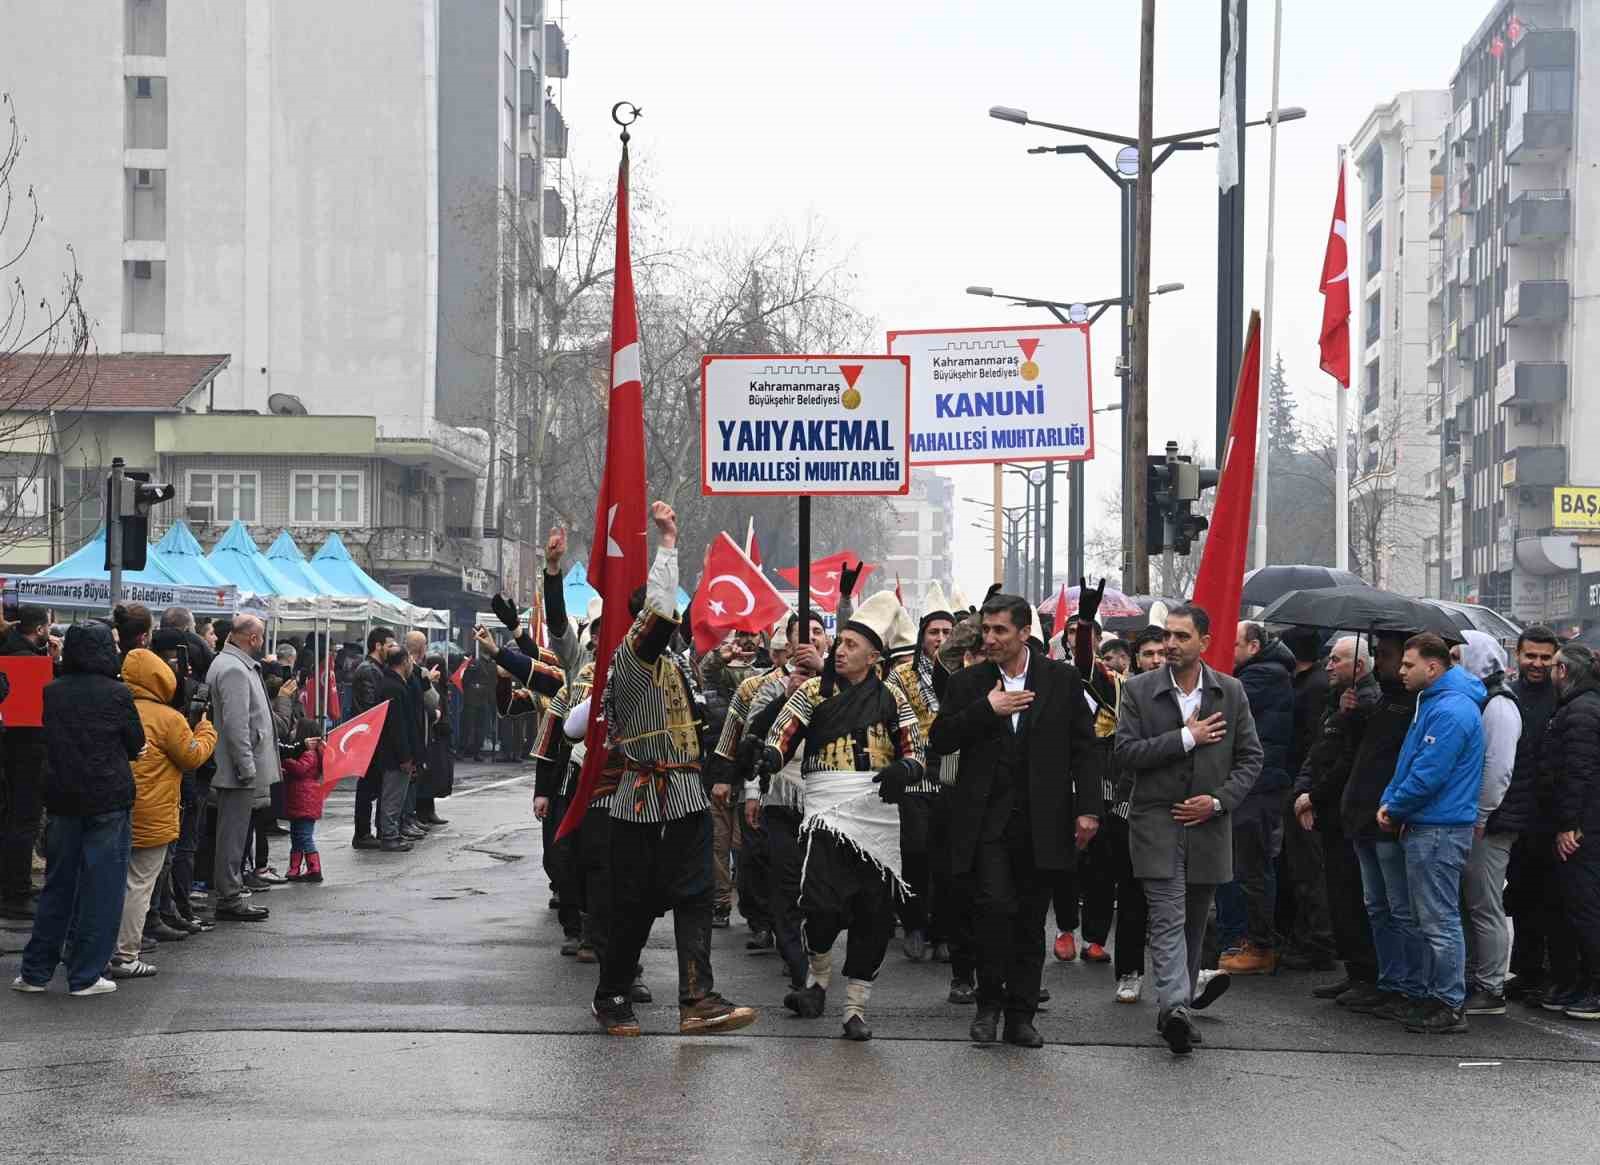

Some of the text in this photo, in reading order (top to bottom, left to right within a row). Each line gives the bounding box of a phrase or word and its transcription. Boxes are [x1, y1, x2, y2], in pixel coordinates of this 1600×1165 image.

[933, 355, 1019, 367] Kahramanmaraş
[933, 367, 1019, 382] Büyükşehir Belediyesi
[750, 381, 840, 393] Kahramanmaraş
[749, 394, 840, 407] Büyükşehir Belediyesi
[935, 384, 1045, 418] KANUNİ
[718, 419, 895, 452] YAHYAKEMAL
[992, 423, 1085, 450] MUHTARLIĞI
[712, 457, 900, 482] MAHALLESİ MUHTARLIĞI
[1561, 494, 1600, 517] BAŞ
[15, 579, 82, 599] Kahramanmaraş
[131, 586, 174, 606] Belediyesi
